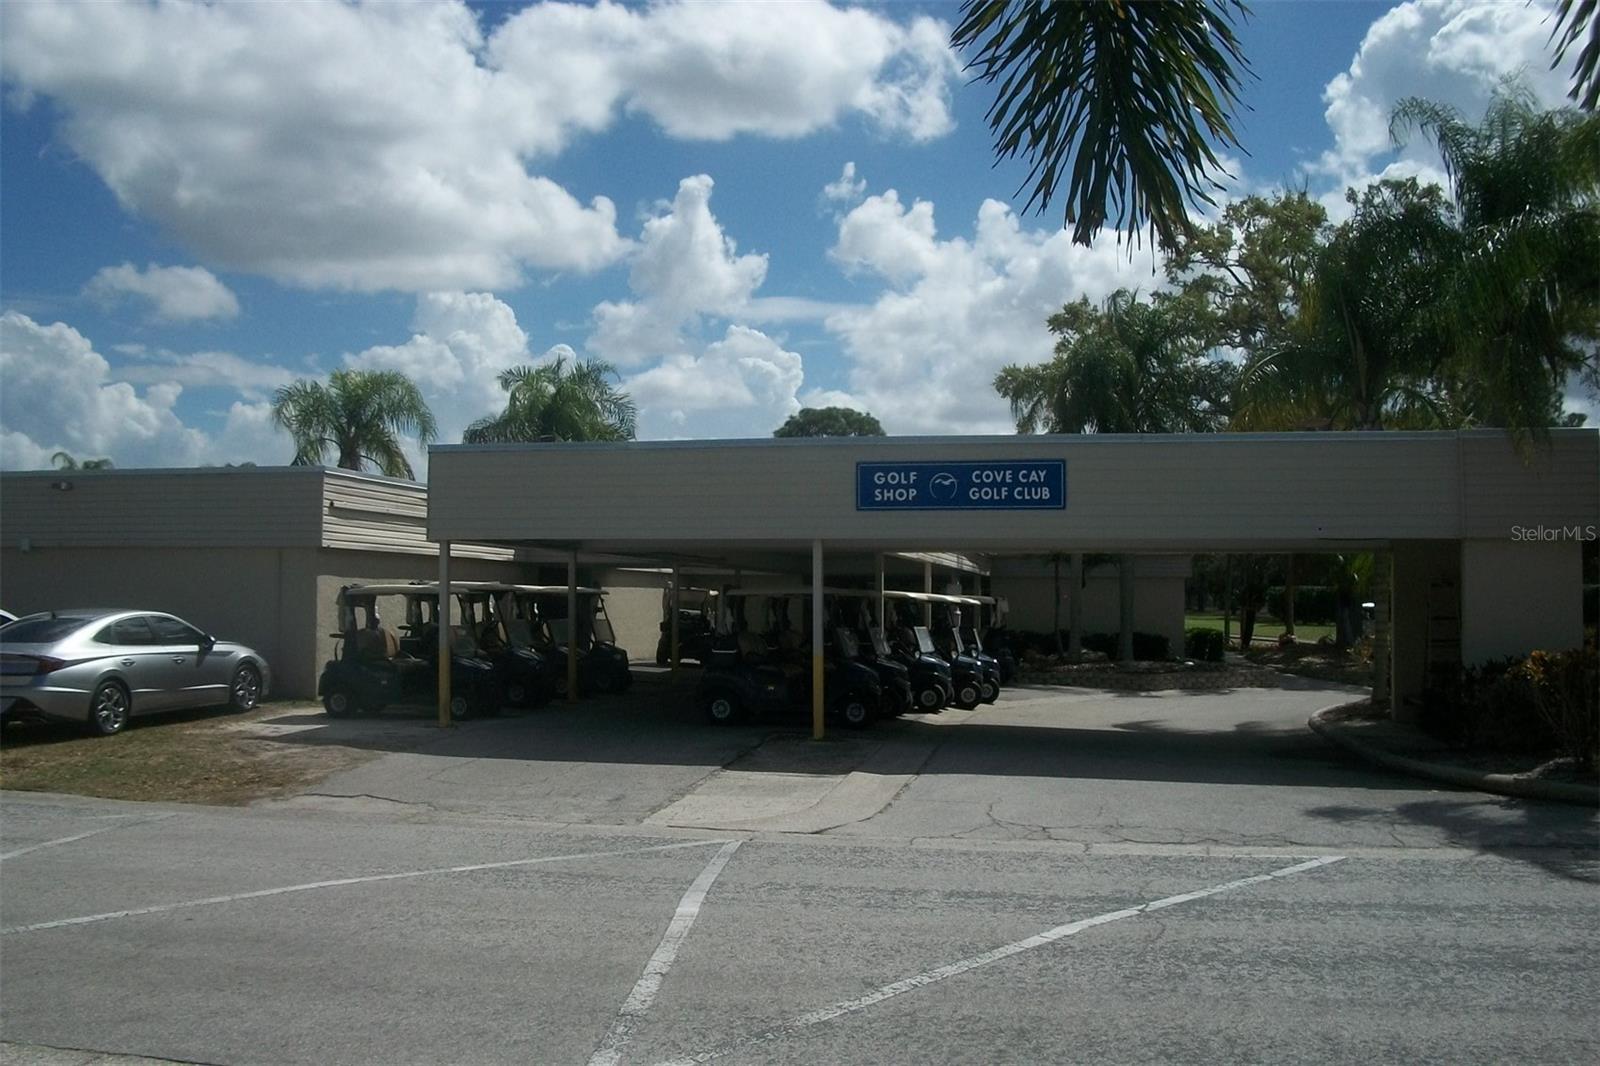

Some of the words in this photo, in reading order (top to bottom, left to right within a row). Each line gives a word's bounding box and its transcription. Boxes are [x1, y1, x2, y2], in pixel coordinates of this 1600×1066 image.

[874, 472, 918, 485] GOLF
[972, 470, 1013, 483] COVE
[1018, 470, 1047, 482] CAY
[874, 488, 917, 501] SHOP
[969, 487, 1008, 500] GOLF
[1014, 486, 1050, 500] CLUB
